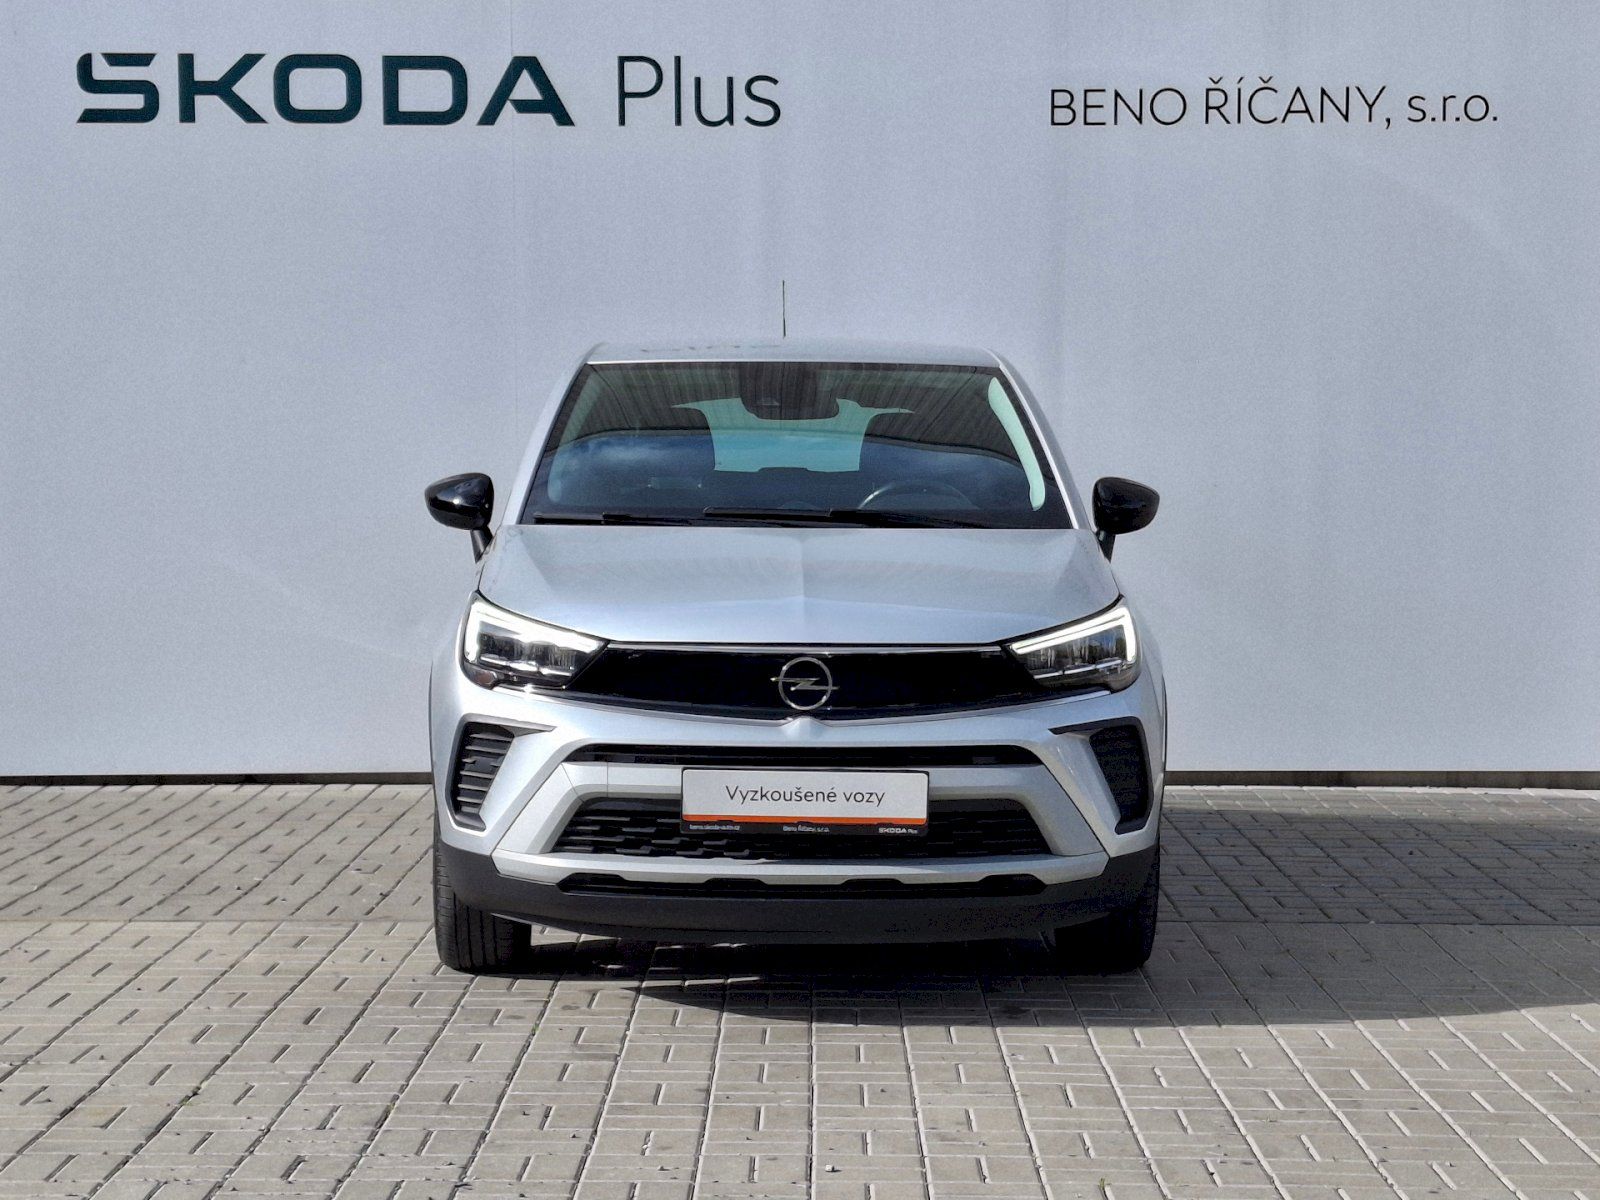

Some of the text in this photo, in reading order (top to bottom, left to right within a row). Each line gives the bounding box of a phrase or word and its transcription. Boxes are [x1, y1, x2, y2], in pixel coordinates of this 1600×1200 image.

[617, 55, 782, 128] Plus
[1050, 75, 1499, 130] BENO ŘÍČANY, s.r.o.
[725, 784, 886, 808] Vyzkoušené vozy
